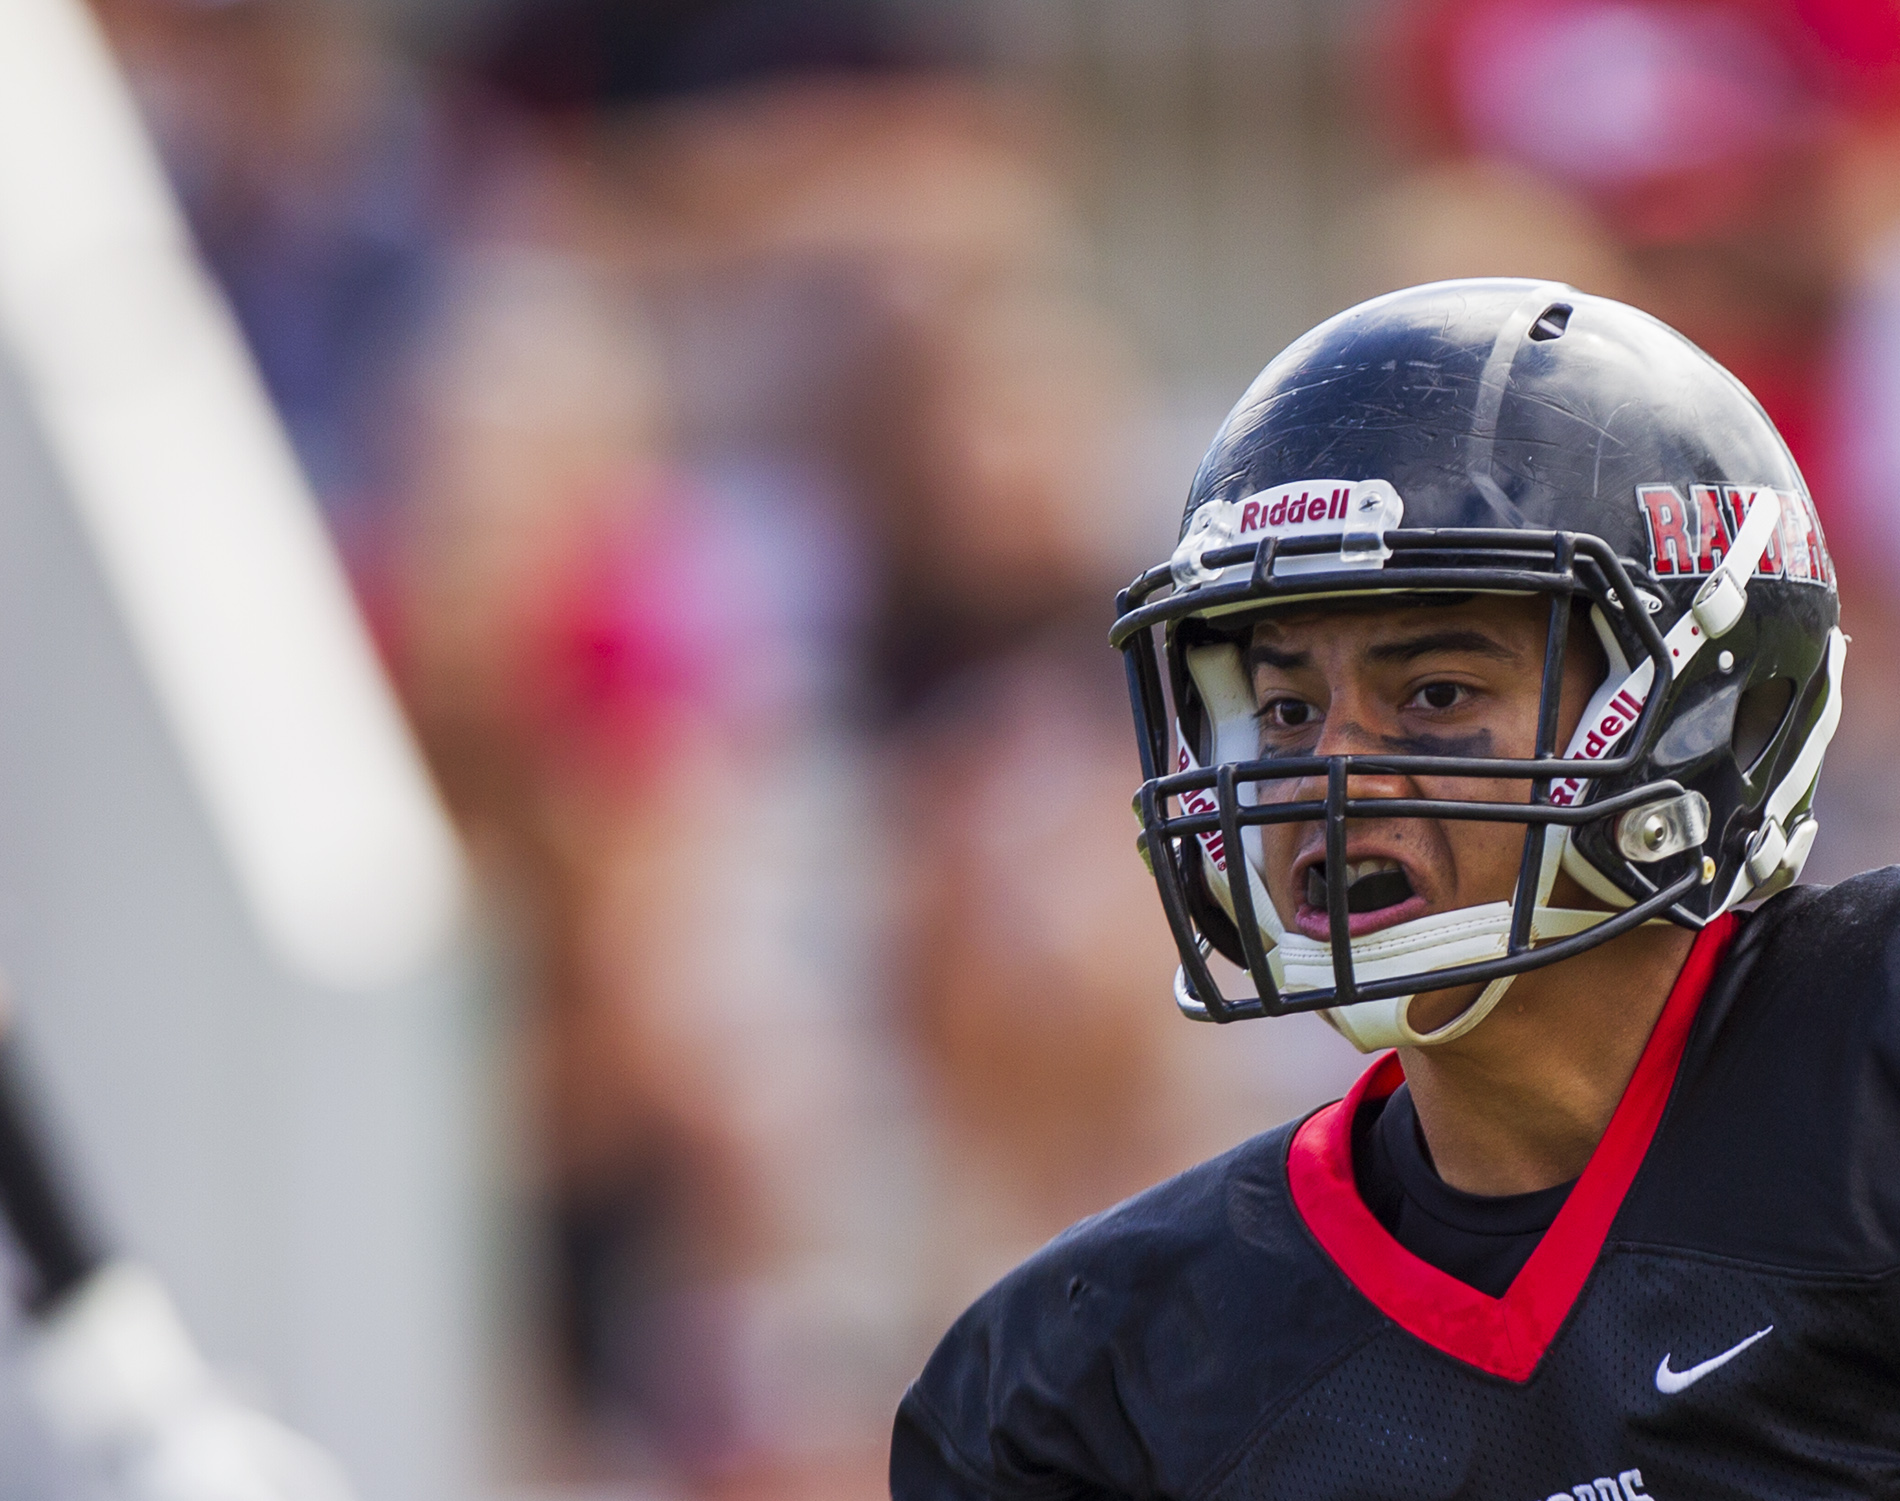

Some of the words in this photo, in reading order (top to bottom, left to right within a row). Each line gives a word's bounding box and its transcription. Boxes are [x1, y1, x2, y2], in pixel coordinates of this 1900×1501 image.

[1240, 488, 1350, 534] Riddell
[1635, 482, 1838, 592] RADER
[1550, 688, 1647, 806] Ridell
